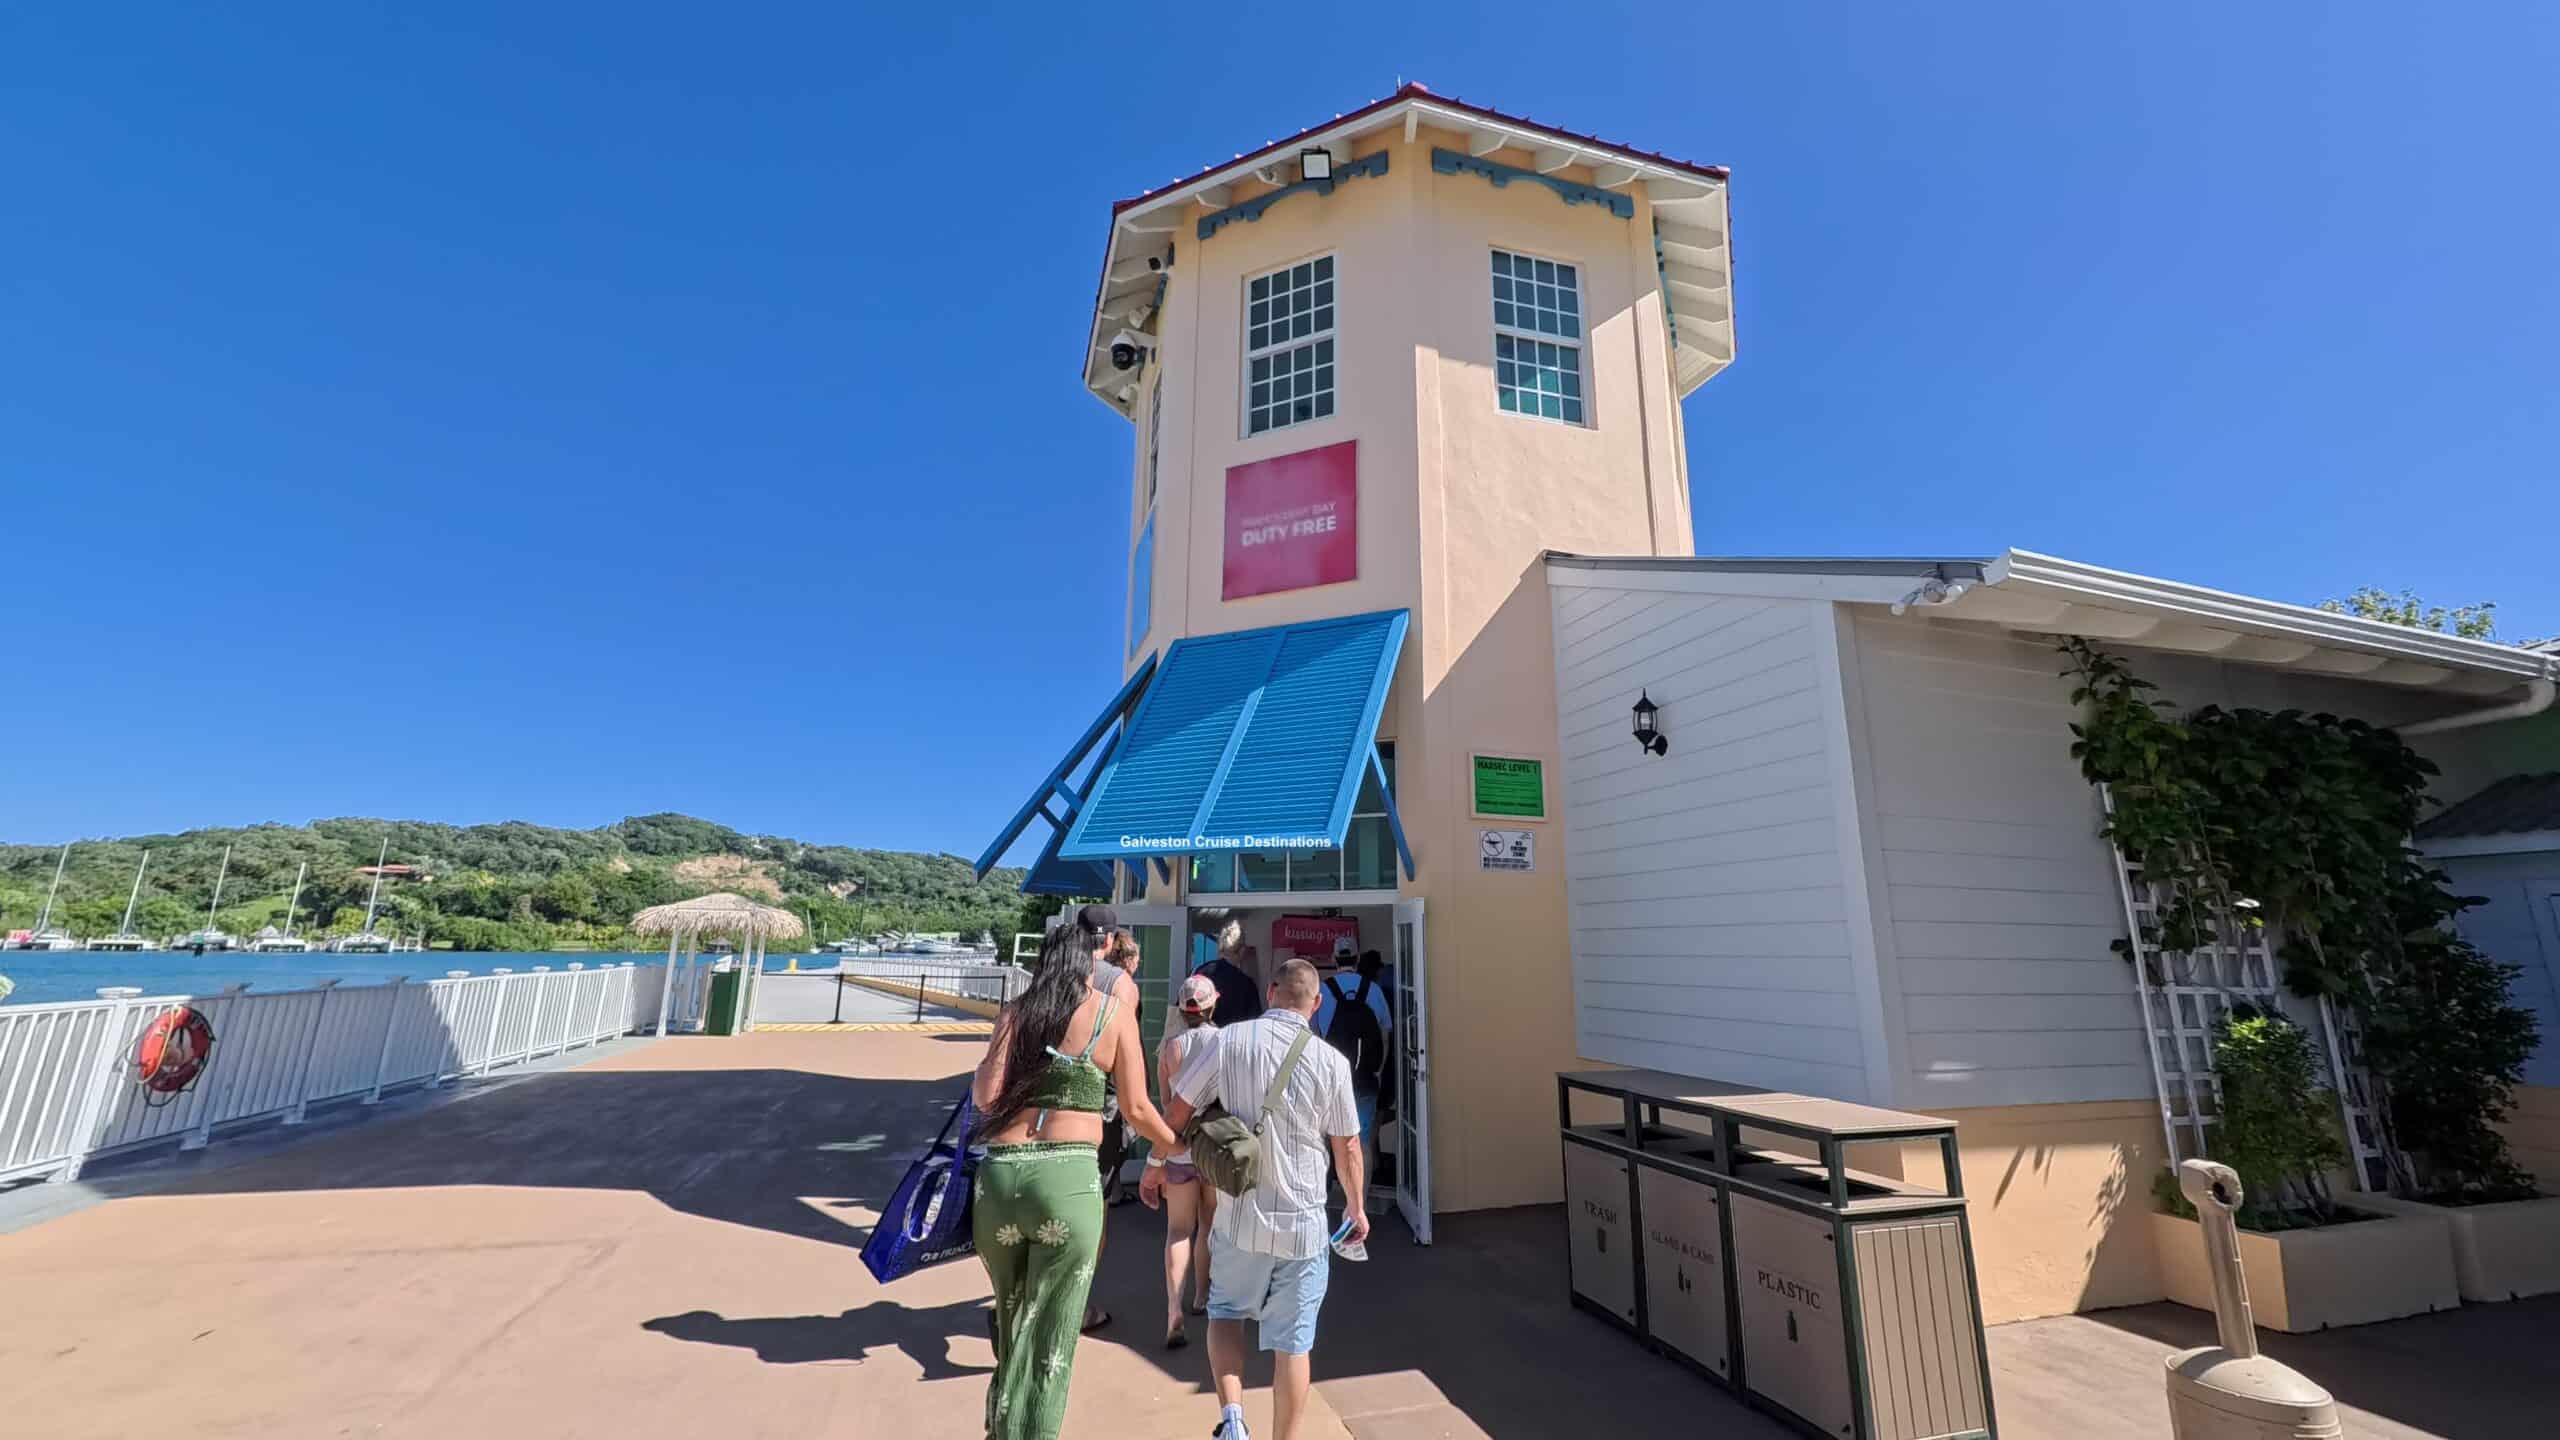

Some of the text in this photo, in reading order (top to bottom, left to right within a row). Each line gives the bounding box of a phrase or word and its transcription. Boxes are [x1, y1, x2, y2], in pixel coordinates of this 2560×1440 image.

[1241, 526, 1288, 547] DUTY
[1292, 516, 1337, 536] FREE
[1508, 763, 1531, 774] LEVEL
[1584, 1199, 1617, 1225] TRASH
[1758, 1269, 1822, 1310] PLASTIC
